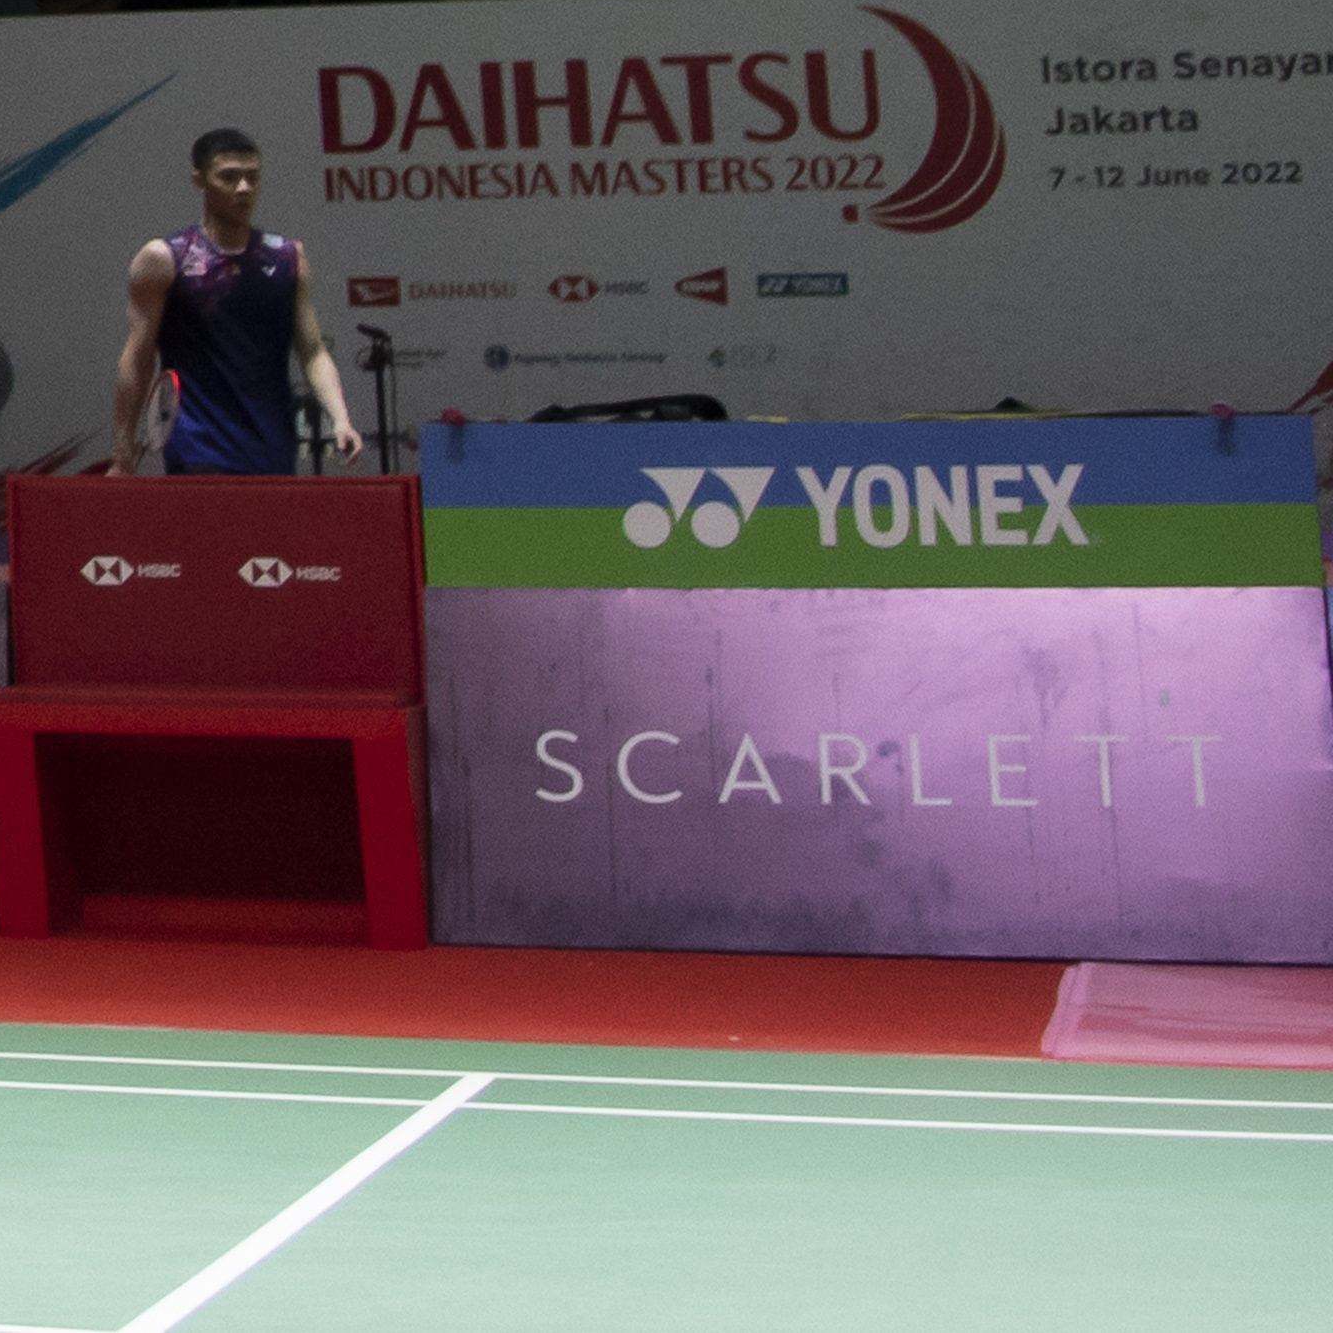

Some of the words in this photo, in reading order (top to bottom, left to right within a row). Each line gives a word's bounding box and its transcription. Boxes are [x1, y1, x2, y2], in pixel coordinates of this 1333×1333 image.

[1041, 54, 1158, 84] Istora
[317, 49, 880, 154] DAIHATSU
[1045, 105, 1200, 136] Jakarta
[323, 161, 560, 203] INDONESIA
[569, 156, 776, 198] MASTERS
[785, 152, 887, 193] 2022
[1048, 166, 1067, 191] 7
[1093, 165, 1125, 188] 12
[1136, 163, 1212, 188] June
[1221, 160, 1304, 185] 2022
[408, 281, 517, 301] DAIHATSU
[794, 462, 1091, 549] YONEX
[137, 563, 182, 578] HSBC
[296, 566, 342, 581] HSBC
[534, 729, 1224, 809] SCARLETT
